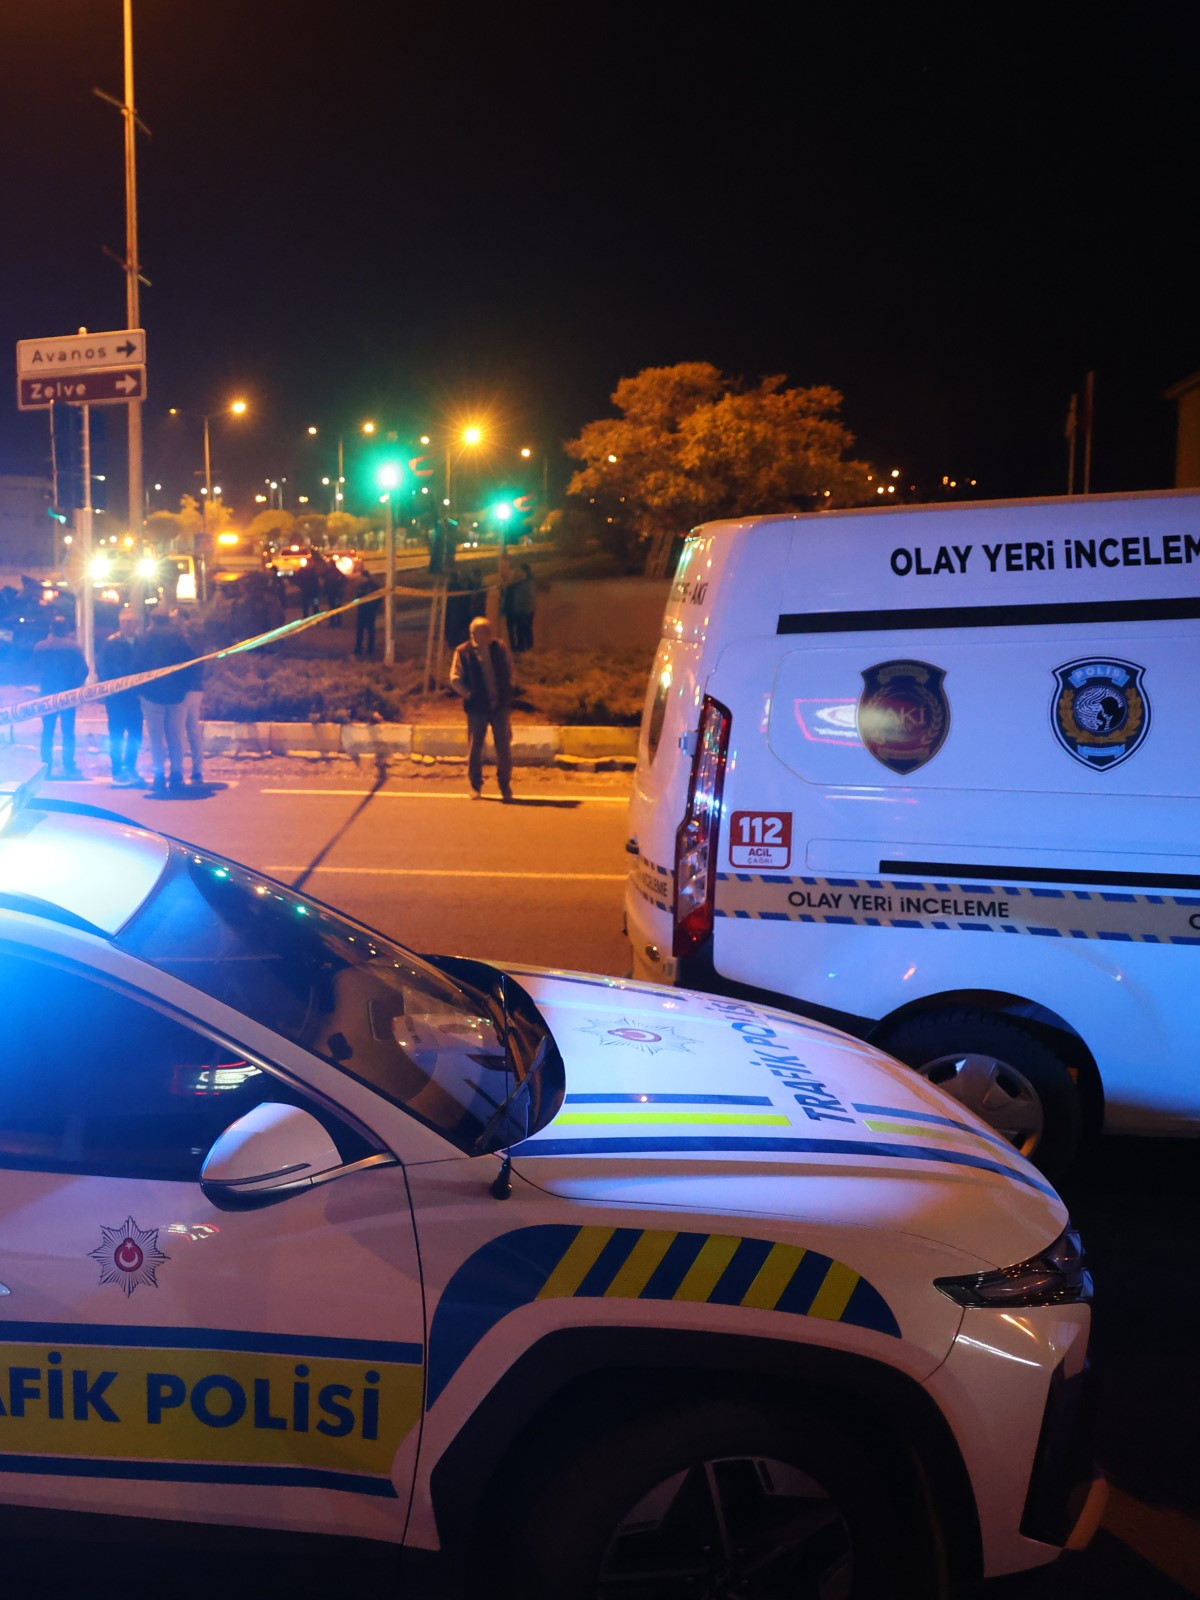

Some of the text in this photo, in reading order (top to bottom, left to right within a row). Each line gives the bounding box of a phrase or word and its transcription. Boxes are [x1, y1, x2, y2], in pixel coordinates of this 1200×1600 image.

[31, 346, 107, 364] Avanos
[30, 381, 87, 399] Zelve
[890, 544, 973, 577] OLAY
[738, 816, 783, 845] 112
[787, 891, 843, 909] OLAY
[749, 1049, 857, 1124] TRAFİK
[146, 1364, 381, 1441] POLİSİ
